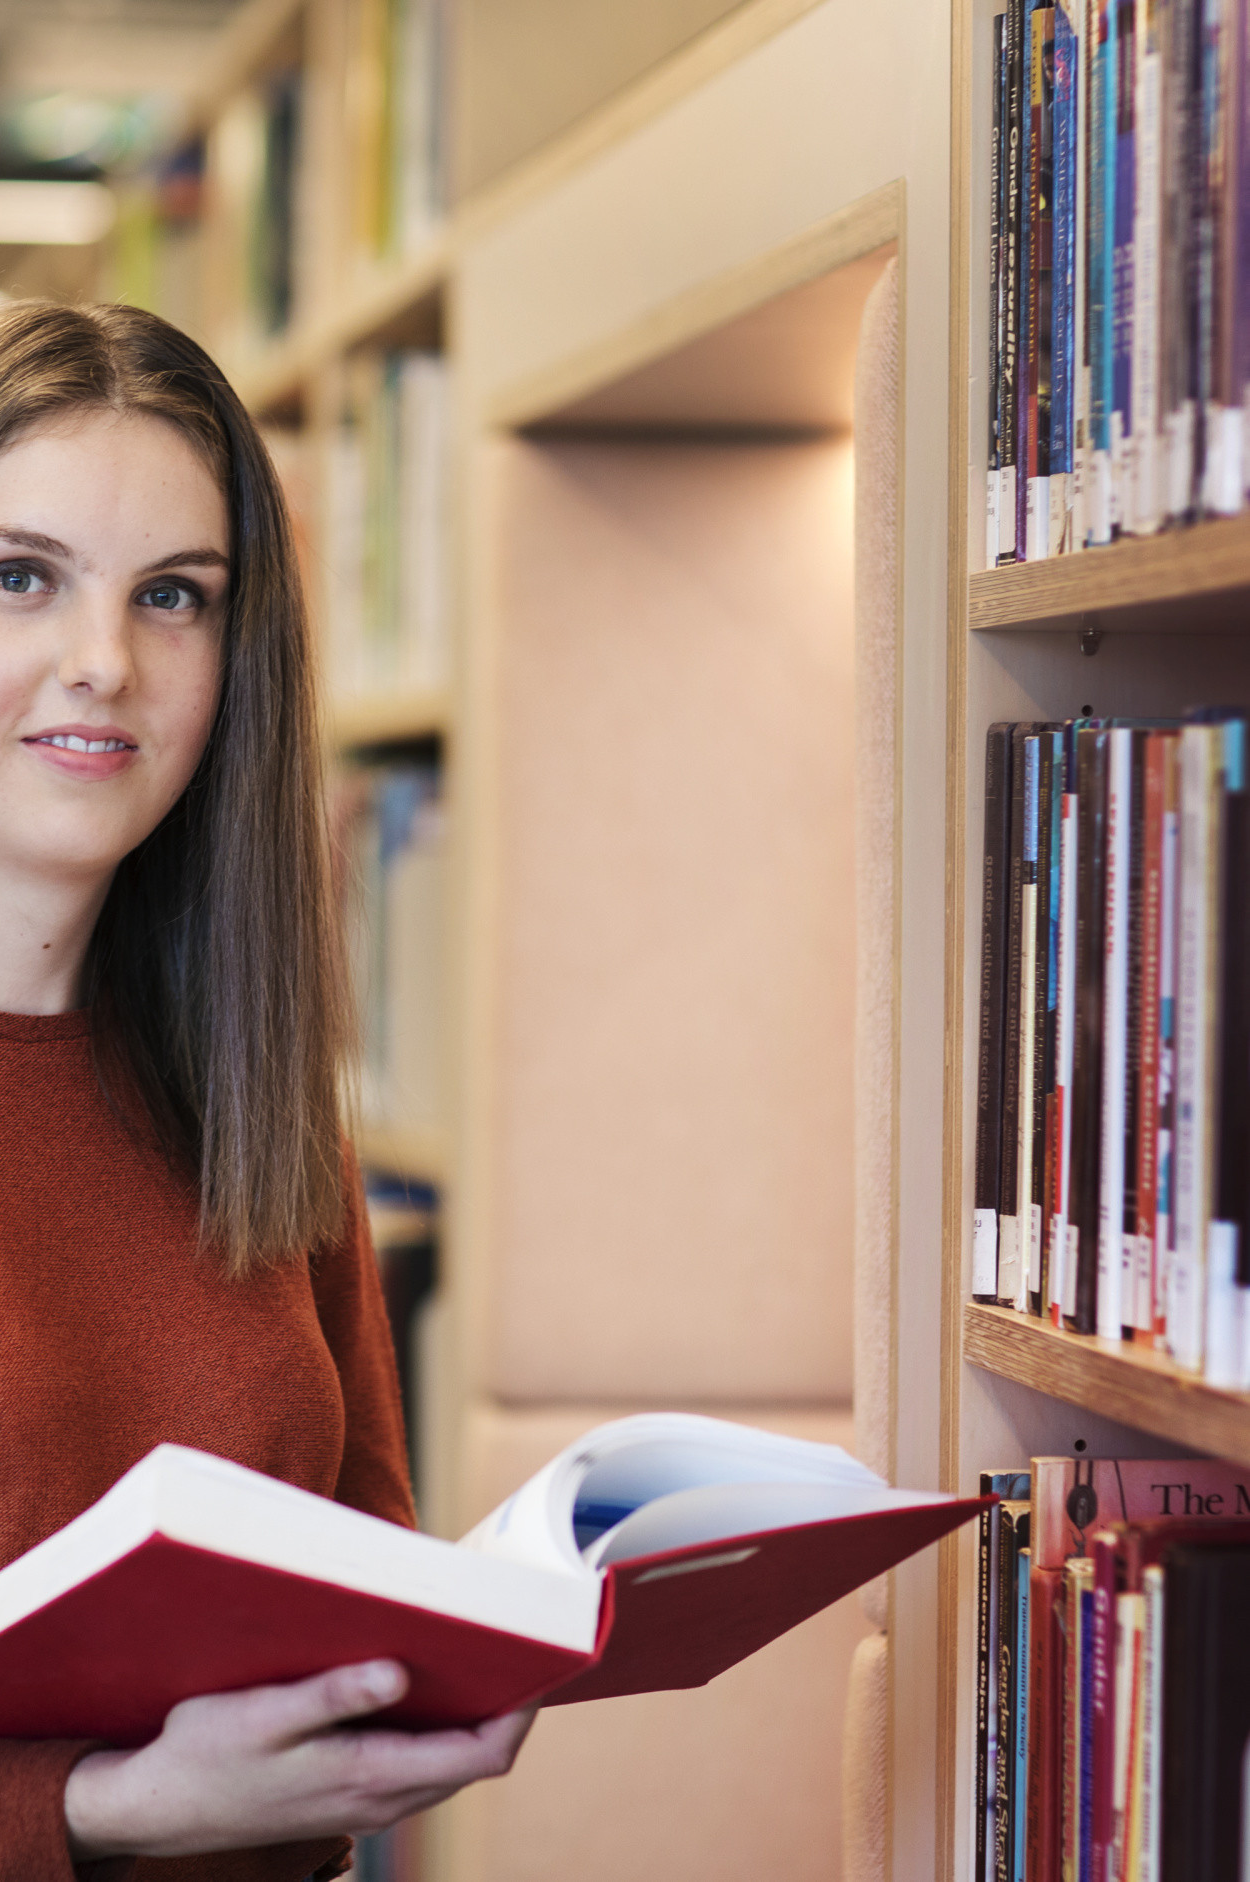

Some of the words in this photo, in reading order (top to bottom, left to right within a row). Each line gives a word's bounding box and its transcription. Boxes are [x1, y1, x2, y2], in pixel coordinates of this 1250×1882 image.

[991, 127, 999, 226] Gendered
[1009, 127, 1019, 221] Gender
[1005, 232, 1015, 386] sexuality
[1056, 302, 1065, 395] SOCIETY
[984, 856, 994, 926] gender,
[1012, 857, 1021, 929] gender,
[984, 933, 992, 1000] culture
[1011, 935, 1020, 1002] culture
[982, 1005, 991, 1038] and
[1009, 1008, 1018, 1041] and
[979, 1045, 990, 1110] society
[1006, 1048, 1016, 1113] society
[1151, 1483, 1224, 1515] The
[1094, 1587, 1109, 1716] Gender
[979, 1661, 987, 1730] object
[1000, 1645, 1011, 1742] Gender
[999, 1749, 1009, 1800] and
